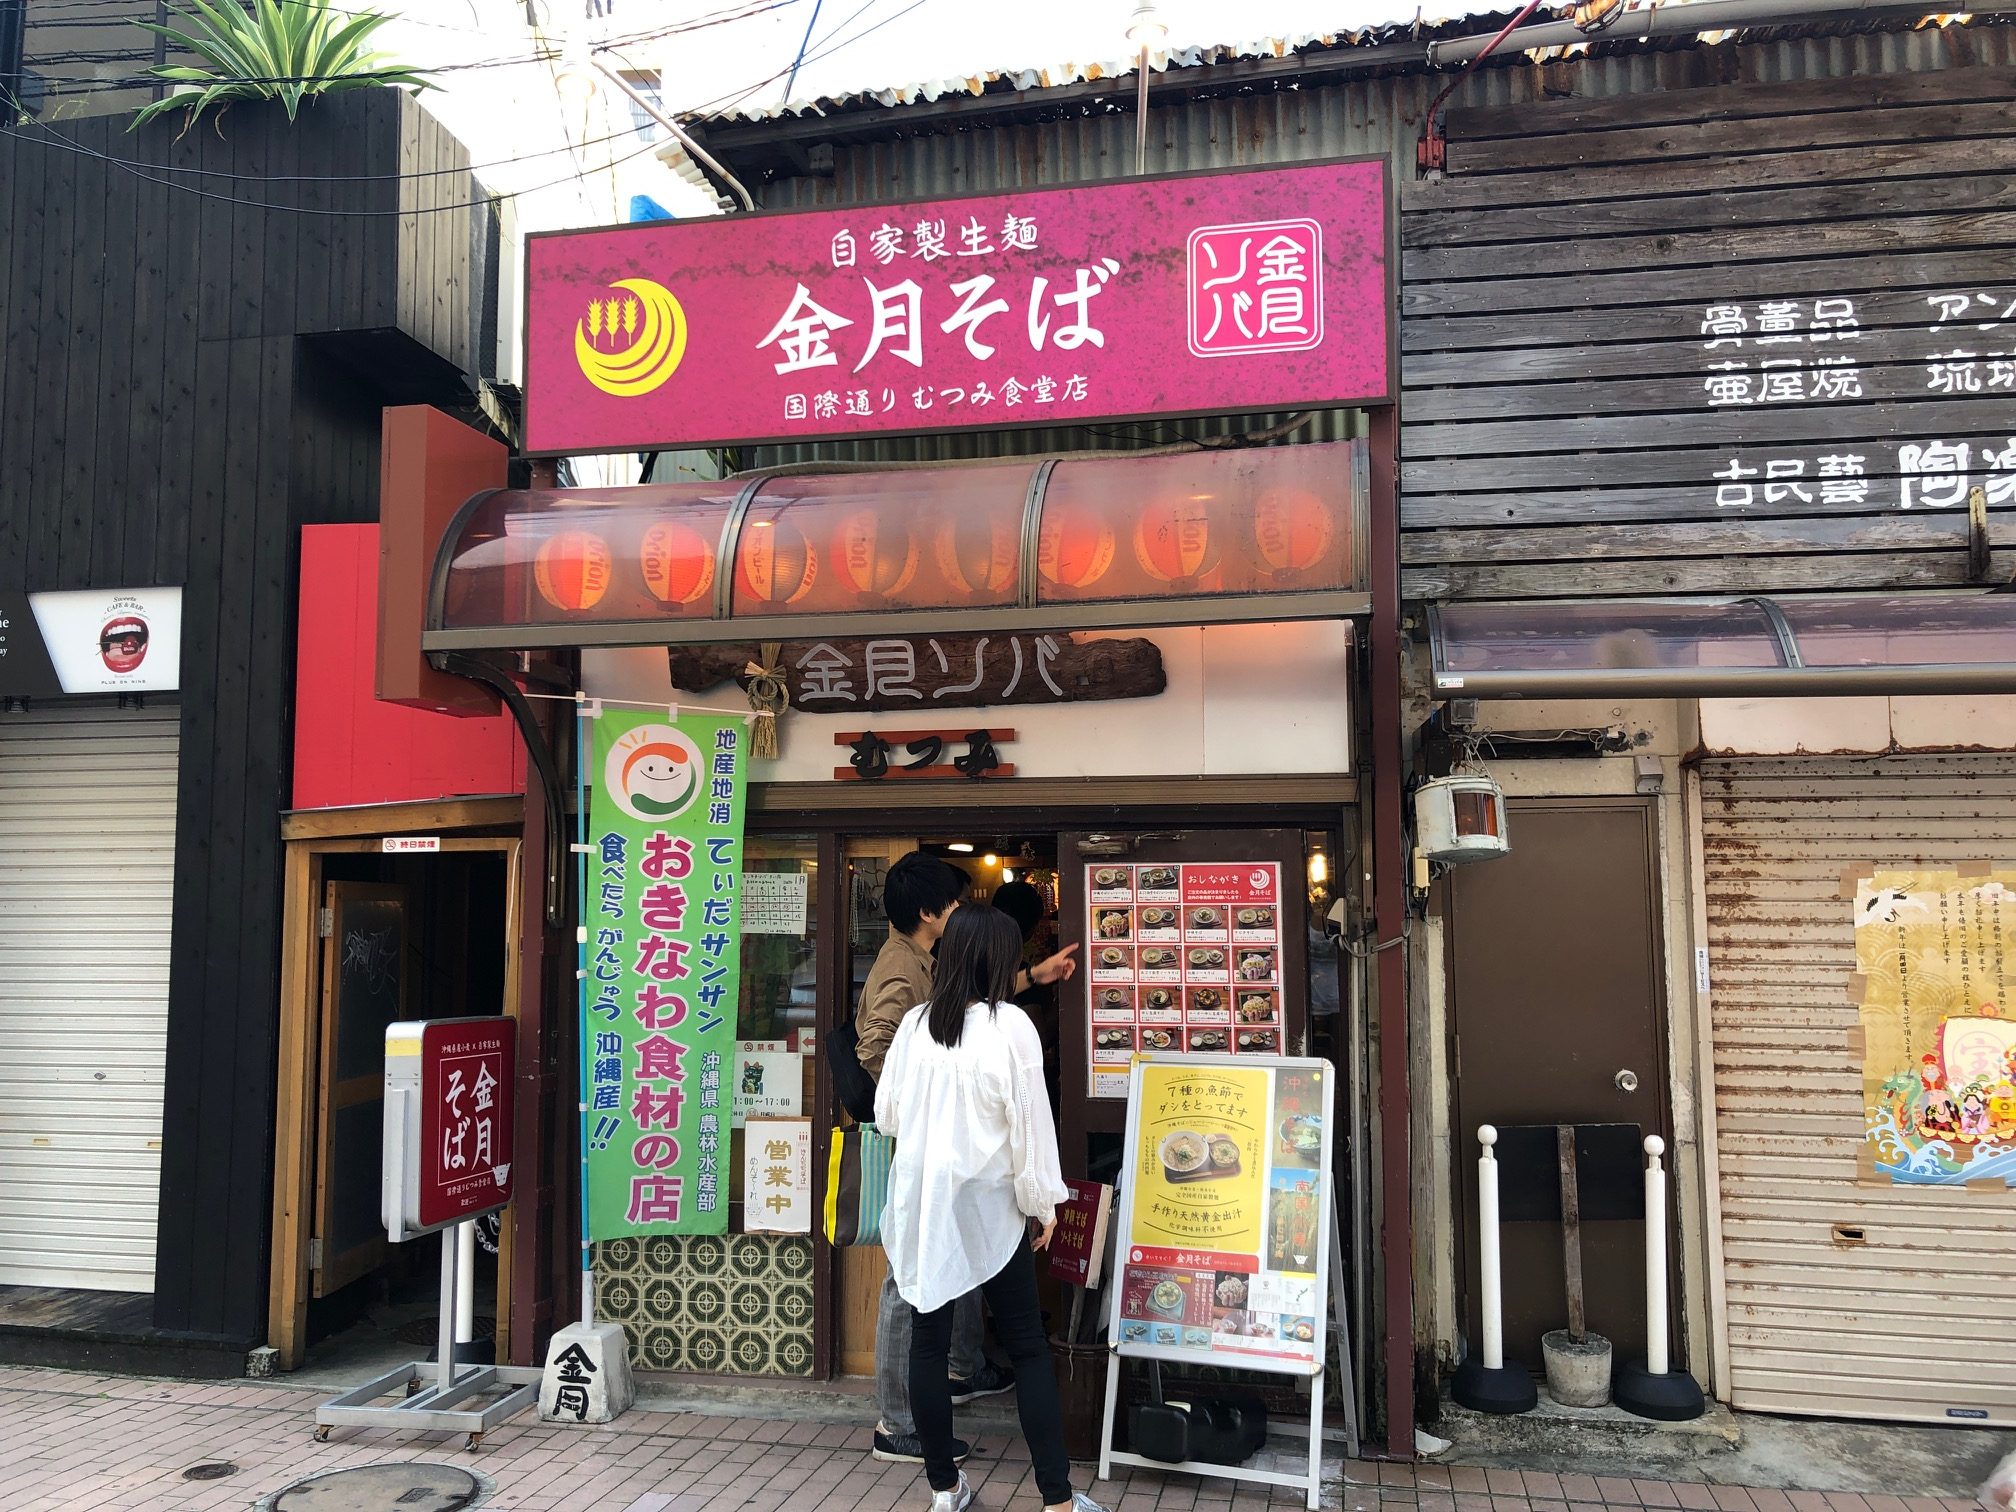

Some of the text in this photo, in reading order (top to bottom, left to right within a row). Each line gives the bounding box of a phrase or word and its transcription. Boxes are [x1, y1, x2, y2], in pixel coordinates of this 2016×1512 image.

[831, 213, 1039, 268] 自家製生麺
[755, 257, 1120, 376] 金月そば
[1701, 299, 1860, 350] 骨董品
[784, 374, 1089, 421] 国際通り むつみ食堂店
[1712, 454, 1868, 507] 古民藝
[646, 529, 666, 581] Orion
[708, 728, 737, 825] 地産地消
[850, 729, 1001, 778] むつみ
[400, 840, 436, 849] 終日禁煙
[597, 831, 629, 920] 食べたら
[1187, 874, 1239, 885] おしながき
[592, 927, 625, 1022] がんじゅう
[623, 829, 695, 1226] おきなわ食材の店
[757, 1043, 775, 1052] 禁煙
[1960, 1037, 2002, 1078] 宝
[444, 1069, 471, 1170] そば
[470, 1060, 498, 1171] 金月
[696, 1050, 721, 1213] 沖縄県 農林水産部
[1159, 1100, 1248, 1118] ダシをとってます
[764, 1139, 793, 1215] 営業中
[1151, 1202, 1242, 1223] 手作り天然黄金出汁
[1175, 1252, 1212, 1266] 金月そば
